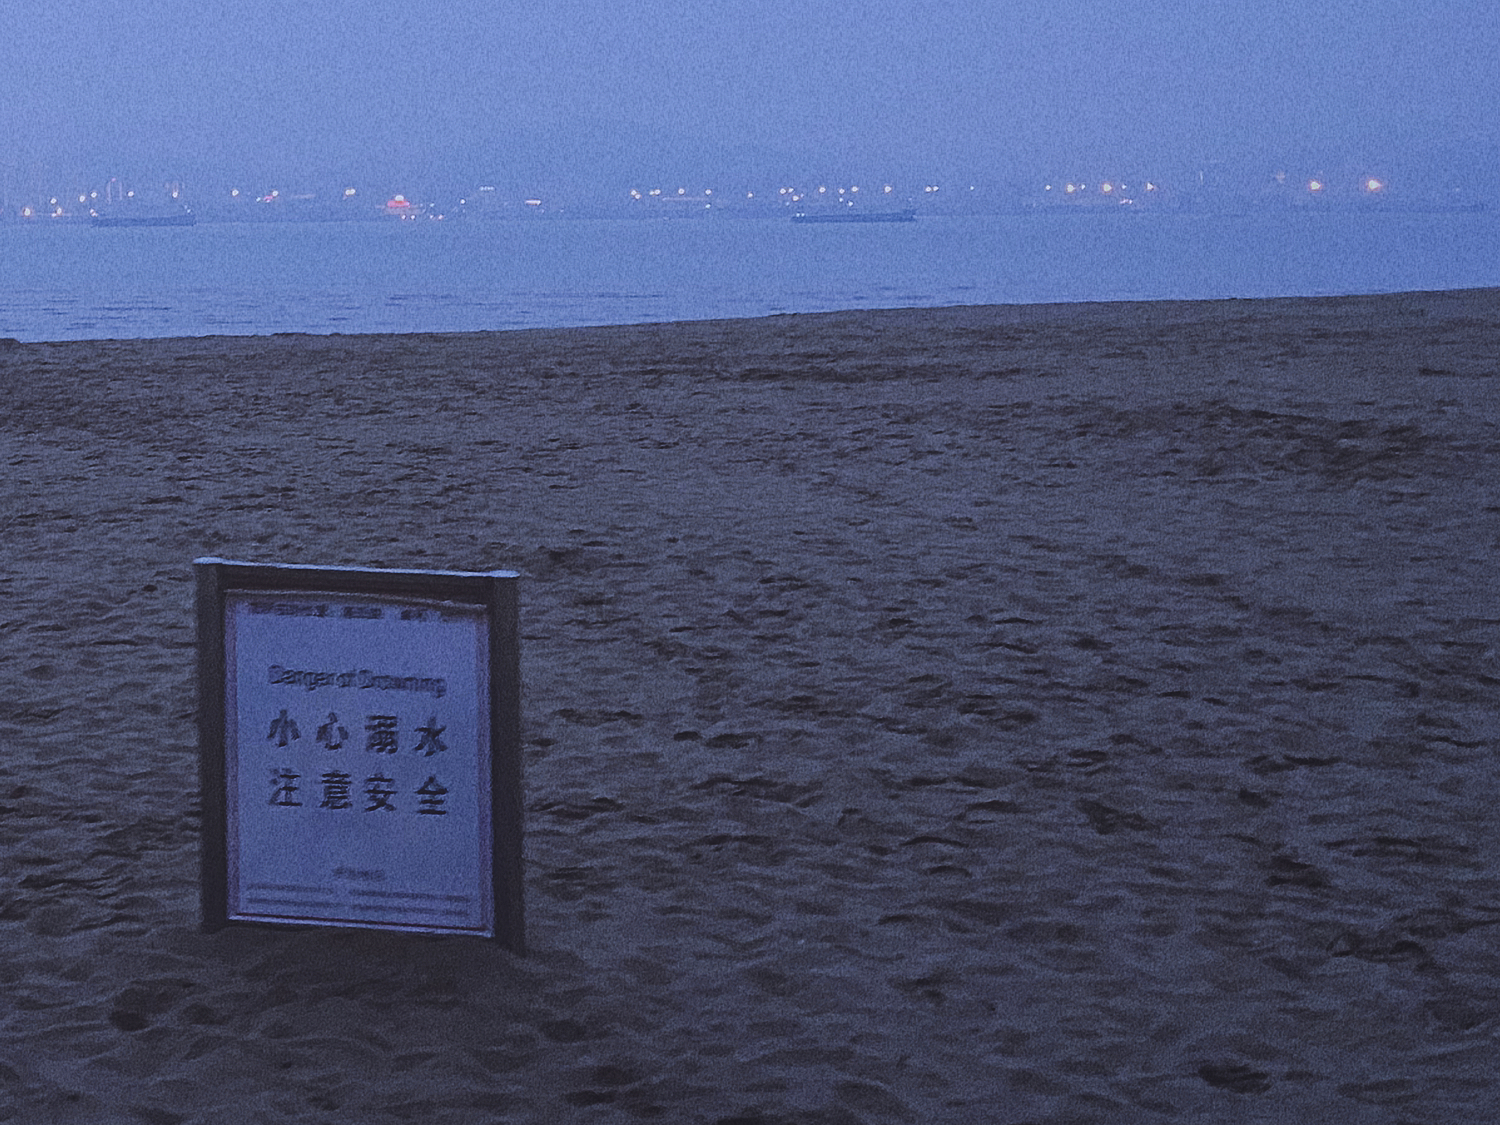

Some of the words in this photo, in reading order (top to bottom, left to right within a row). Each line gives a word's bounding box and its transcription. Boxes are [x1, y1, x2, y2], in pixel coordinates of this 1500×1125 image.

[267, 709, 448, 757] 小心溺水
[268, 766, 448, 816] 注意安全
